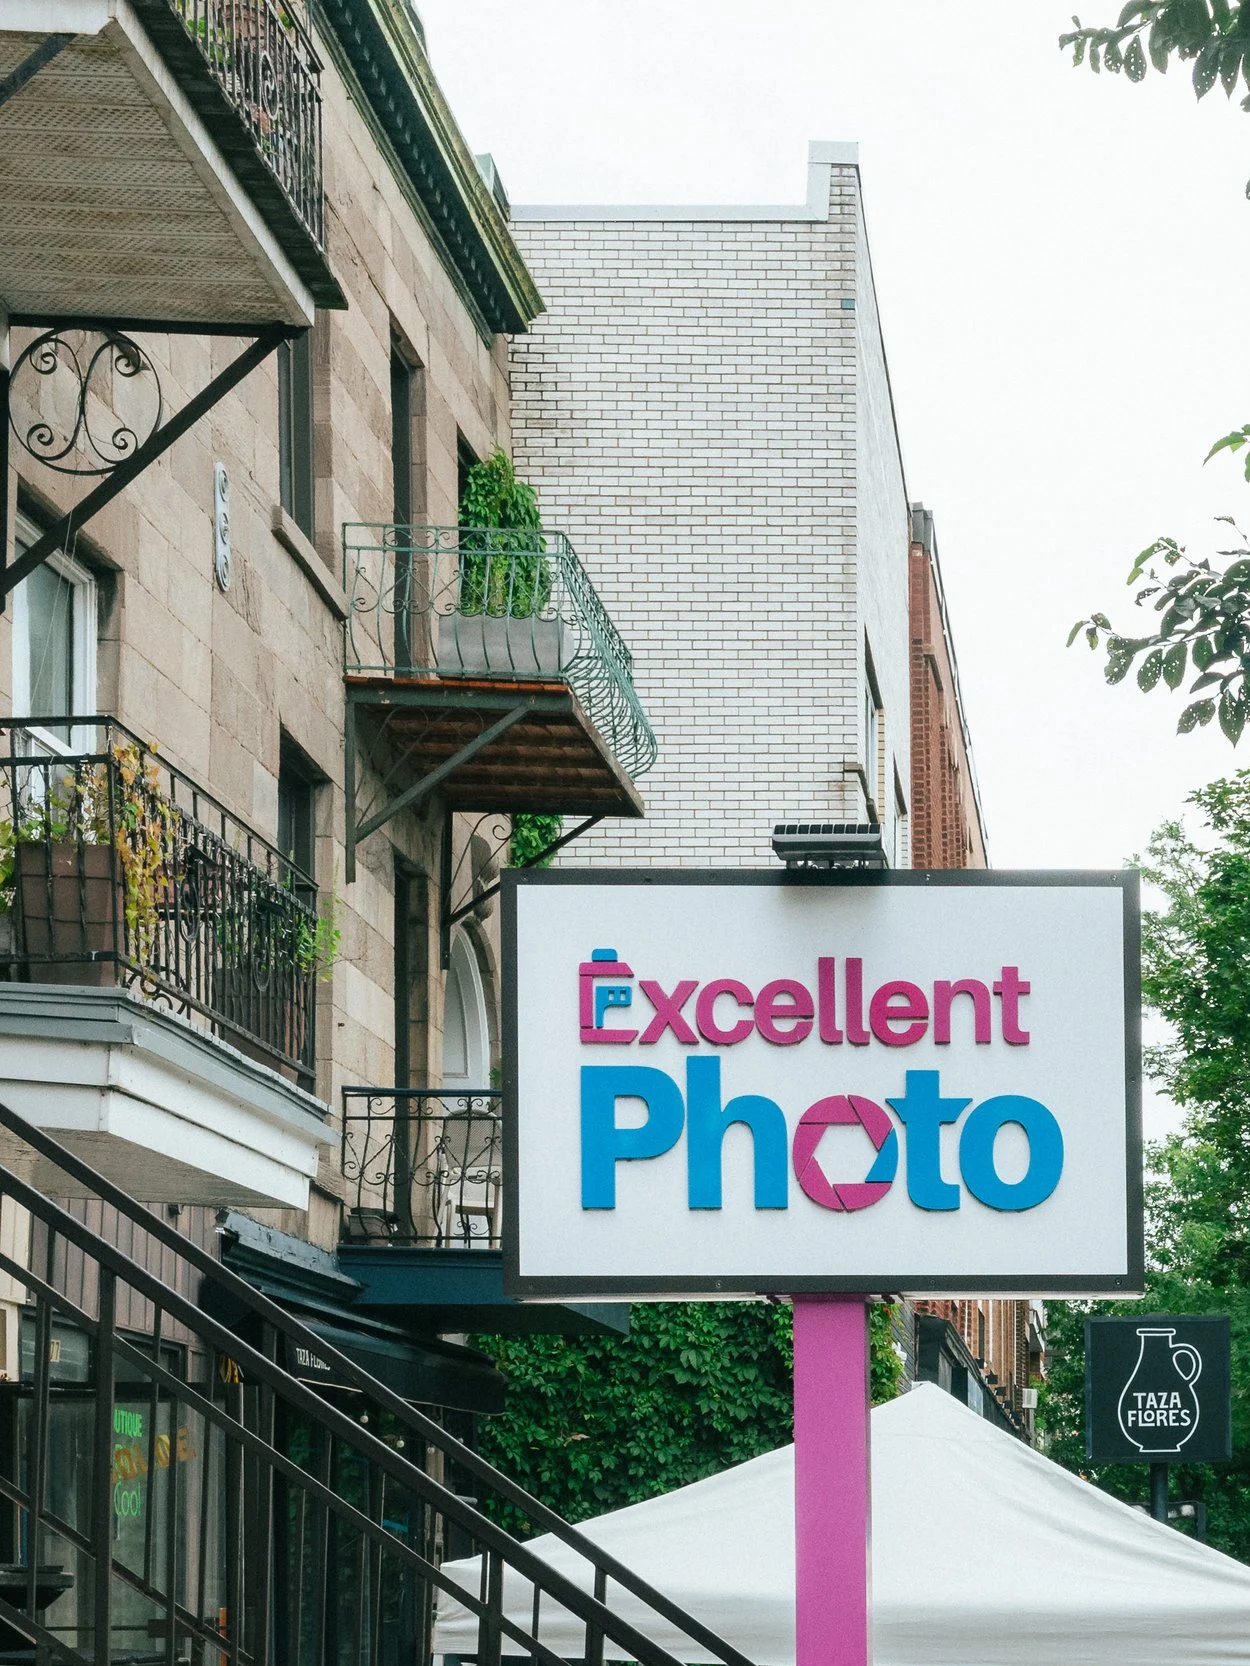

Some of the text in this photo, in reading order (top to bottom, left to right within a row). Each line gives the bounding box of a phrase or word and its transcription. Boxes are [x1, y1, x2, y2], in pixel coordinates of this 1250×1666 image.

[578, 949, 1031, 1047] Excellent
[580, 1055, 1065, 1213] Photo
[295, 1347, 310, 1367] TAZA
[1132, 1391, 1182, 1409] TAZA
[114, 1408, 143, 1439] UTIQUE
[1127, 1409, 1191, 1427] FLORES
